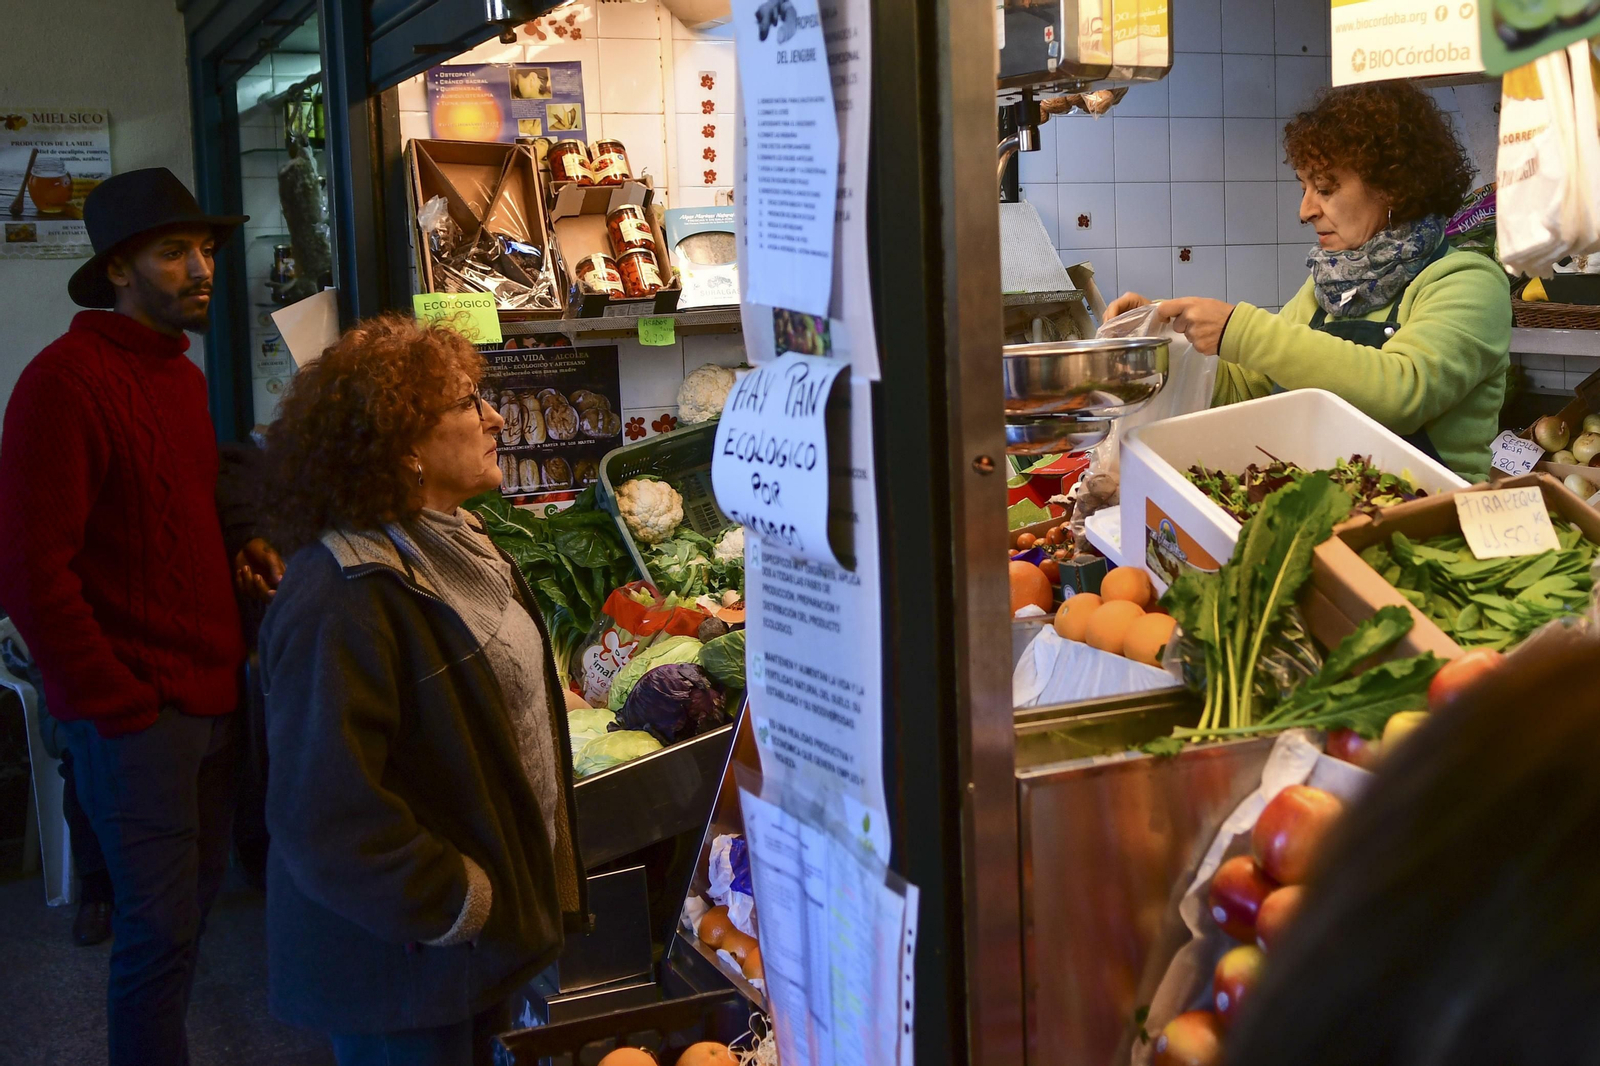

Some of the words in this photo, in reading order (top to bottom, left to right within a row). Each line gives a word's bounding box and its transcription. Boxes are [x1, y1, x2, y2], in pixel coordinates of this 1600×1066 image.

[1335, 12, 1427, 33] www.biocordoba.org
[776, 50, 788, 64] DEL
[1369, 42, 1470, 69] BIOCórdoba
[32, 113, 103, 124] MIELSICO
[423, 299, 491, 311] ECOLÓGICO
[495, 355, 520, 363] PURA
[732, 368, 775, 414] HAY
[784, 362, 827, 418] PAN
[723, 428, 817, 471] ECOLOGICO
[751, 472, 782, 508] POR
